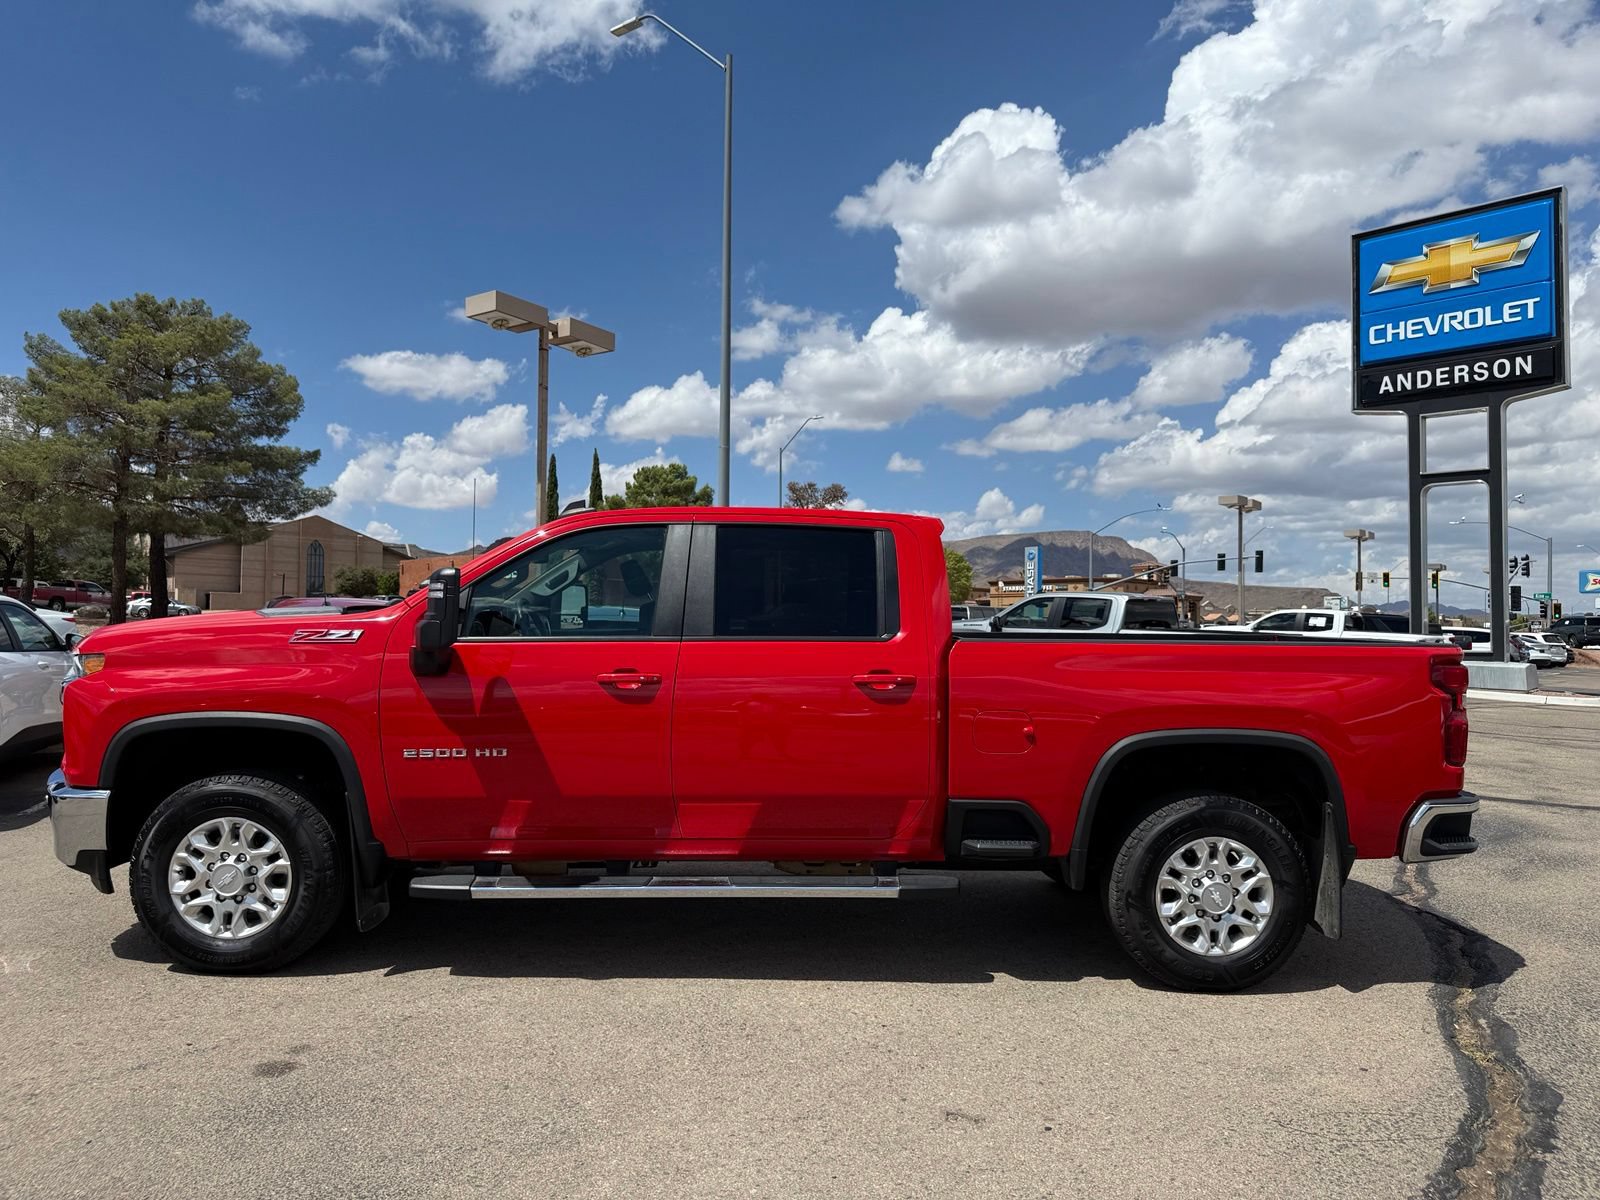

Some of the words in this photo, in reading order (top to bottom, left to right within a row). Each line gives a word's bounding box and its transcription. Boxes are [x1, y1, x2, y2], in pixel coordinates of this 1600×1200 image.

[1368, 297, 1540, 345] CHEVROLET
[1379, 355, 1533, 395] ANDERSON
[288, 628, 364, 643] Z71
[403, 748, 467, 758] 2500
[475, 748, 507, 757] HD
